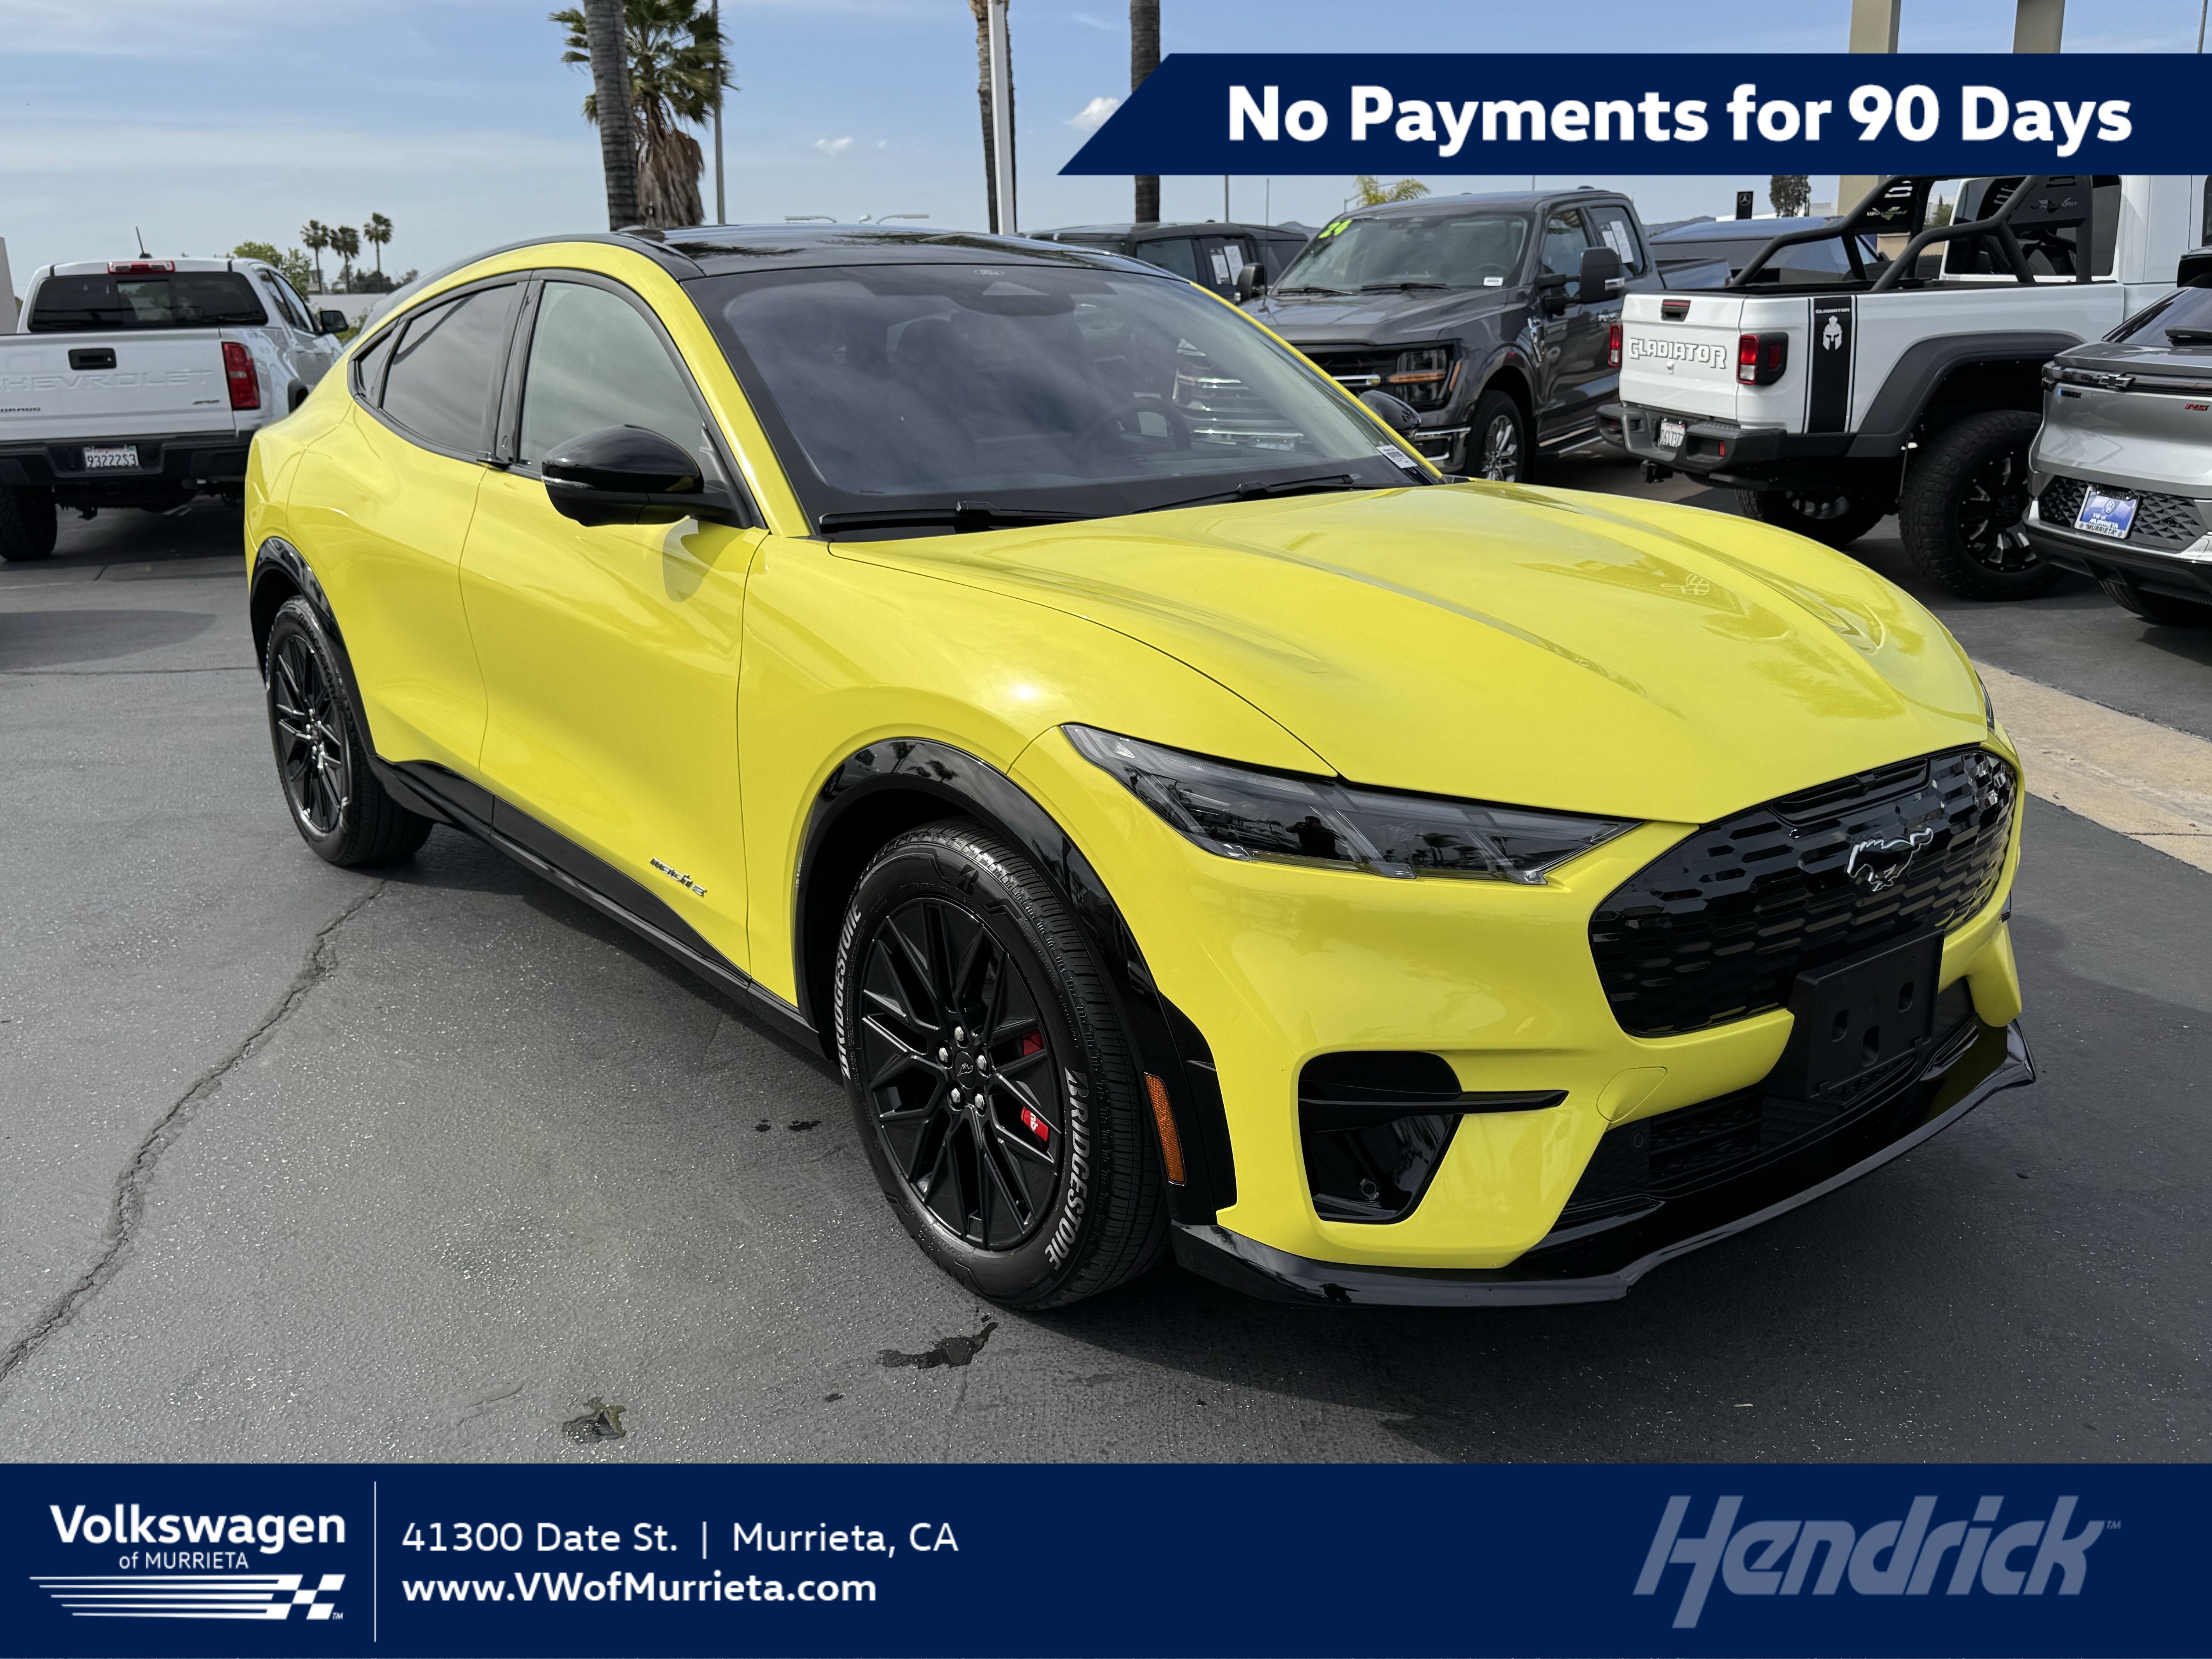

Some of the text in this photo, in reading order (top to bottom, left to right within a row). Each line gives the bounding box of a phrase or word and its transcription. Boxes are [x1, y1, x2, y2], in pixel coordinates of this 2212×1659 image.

[0, 370, 214, 392] HEVROLET
[1629, 337, 1727, 369] GLADIATOR
[834, 903, 862, 1080] BRIDGESTONE
[1045, 1067, 1090, 1271] BRIDGESTONE
